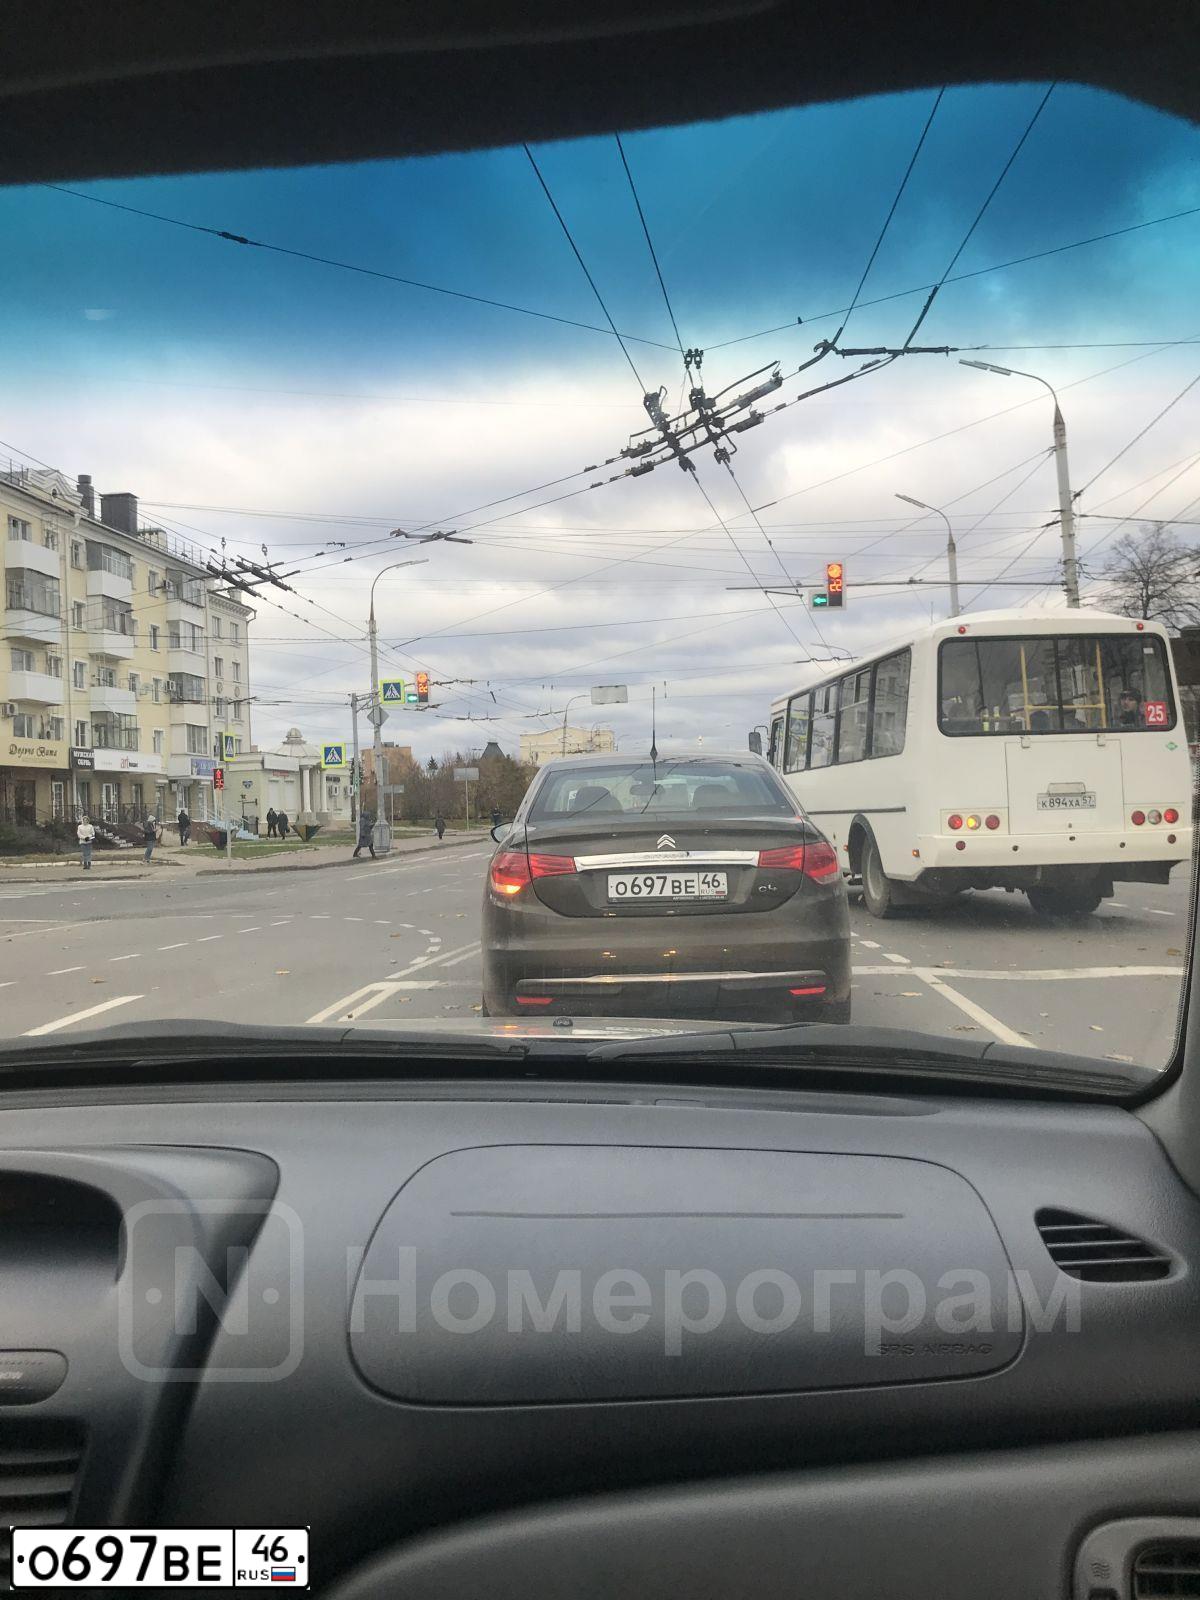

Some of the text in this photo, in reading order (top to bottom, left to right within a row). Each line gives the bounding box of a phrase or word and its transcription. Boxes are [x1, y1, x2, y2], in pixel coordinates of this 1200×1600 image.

[1147, 704, 1164, 722] 25
[615, 874, 721, 896] О697ВЕ 46
[876, 1343, 994, 1356] SRS AIRBAG
